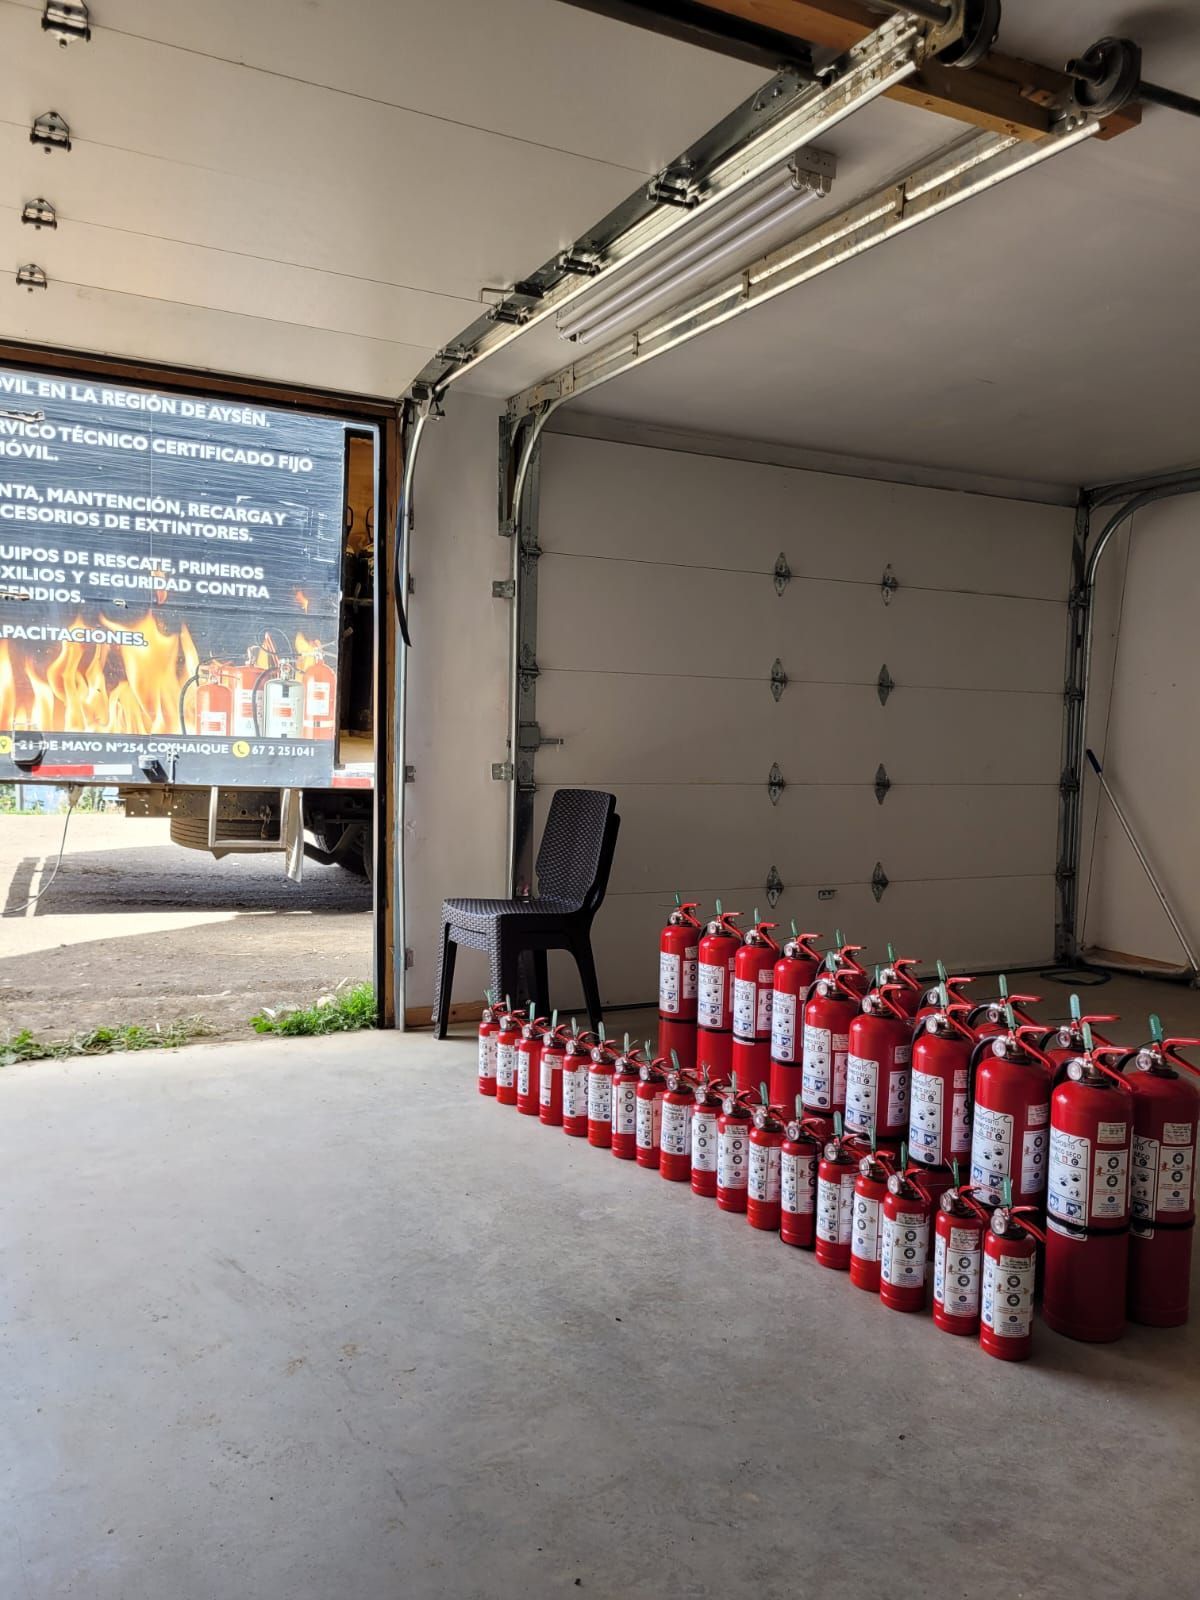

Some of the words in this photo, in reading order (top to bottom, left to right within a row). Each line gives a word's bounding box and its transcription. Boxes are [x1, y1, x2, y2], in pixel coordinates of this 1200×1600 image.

[0, 376, 34, 395] VIL
[39, 382, 66, 400] EN
[71, 386, 99, 404] LA
[102, 389, 177, 415] REGIÓN
[181, 401, 207, 417] DE
[207, 404, 270, 428] AYSÉN.
[58, 424, 149, 452] TÉCNICO
[152, 438, 275, 468] CERTIFICADO
[278, 456, 314, 474] FIJO
[47, 487, 187, 517] MANTENCIÓN,
[188, 505, 271, 525] RECARGA
[273, 511, 287, 527] Y
[104, 513, 131, 530] DE
[134, 516, 254, 543] EXTINTORES.
[63, 550, 89, 565] DE
[93, 552, 177, 573] RESCATE,
[178, 559, 264, 580] PRIMEROS
[0, 565, 66, 583] XILIOS
[71, 570, 85, 584] Y
[88, 571, 192, 593] SEGURIDAD
[195, 581, 270, 600] CONTRA
[0, 624, 148, 648] PACITACIONES.
[62, 740, 104, 753] MAYO
[252, 745, 266, 756] 67
[268, 745, 276, 756] 2
[278, 745, 316, 758] 251041
